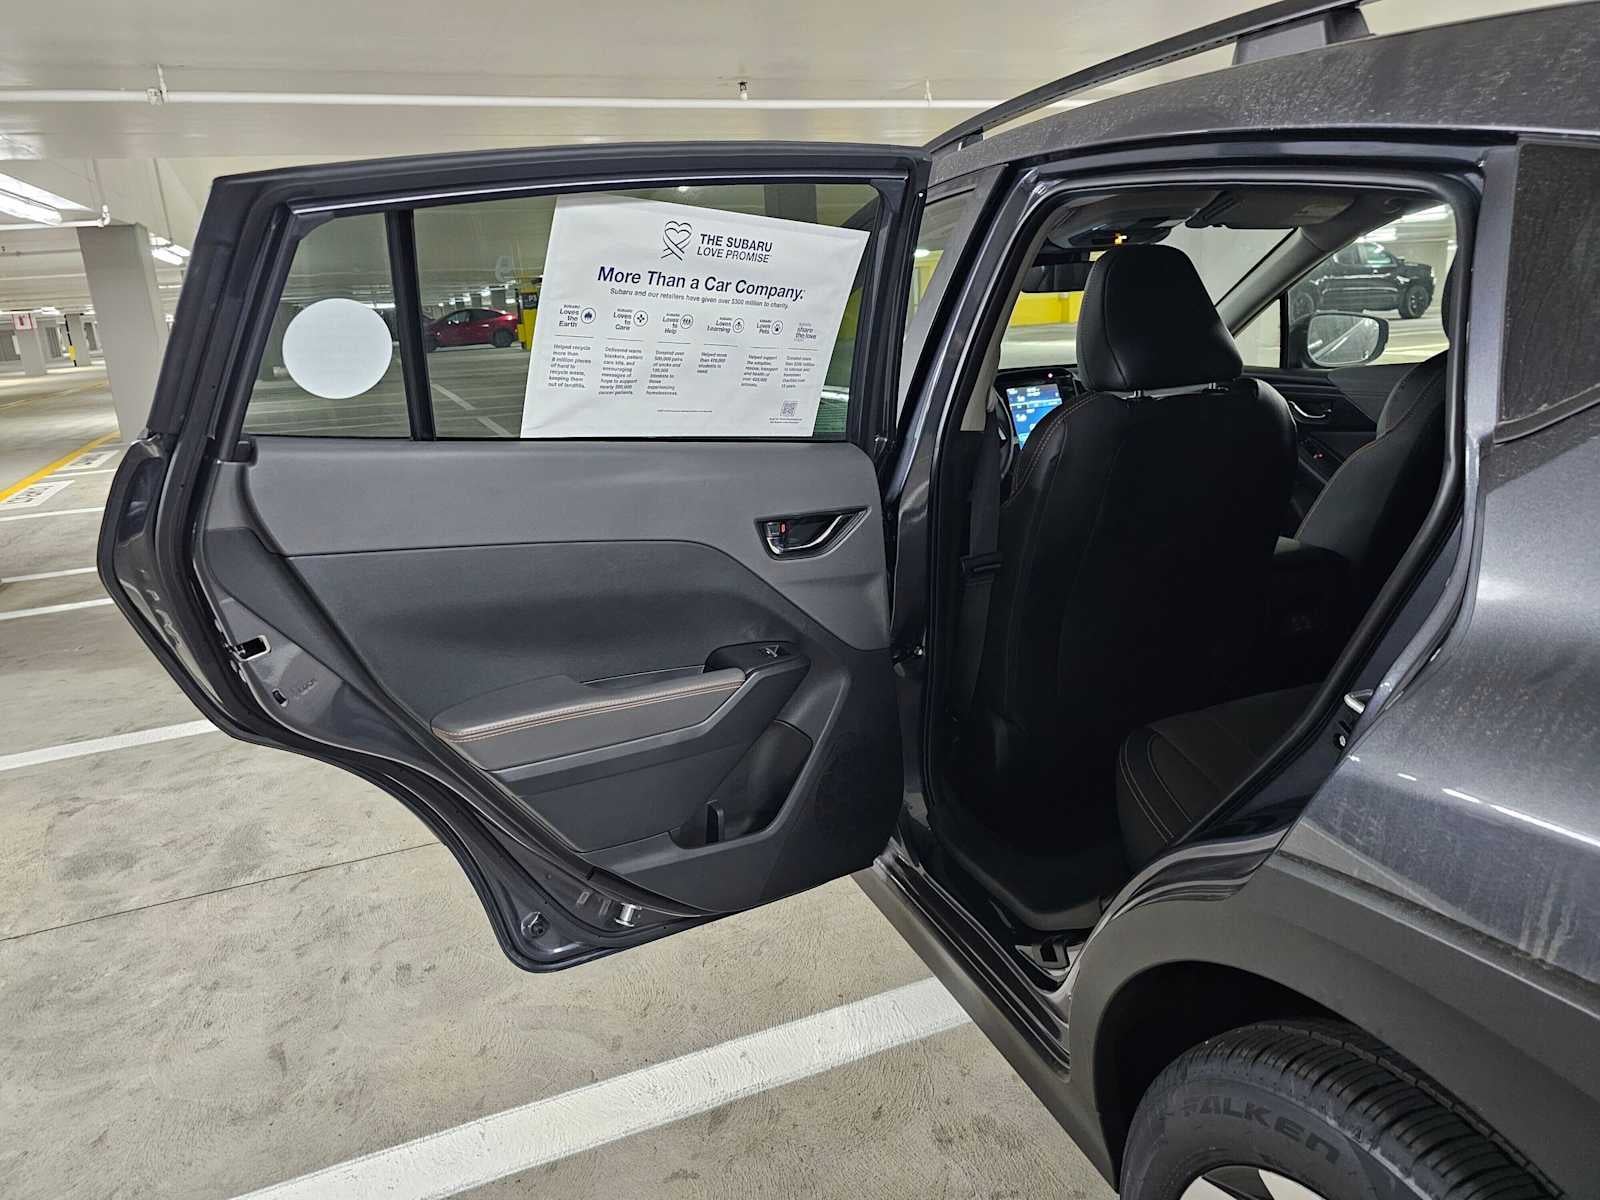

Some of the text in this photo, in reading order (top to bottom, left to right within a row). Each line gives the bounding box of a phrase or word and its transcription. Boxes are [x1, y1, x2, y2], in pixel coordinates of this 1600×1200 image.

[700, 234, 772, 252] THE SUBARU
[697, 247, 770, 263] LOVE PROMISE
[598, 267, 641, 284] More
[648, 271, 686, 288] Than
[690, 278, 699, 289] a
[705, 277, 731, 292] Car
[660, 292, 684, 300] retailers
[707, 325, 731, 333] Learning
[1181, 1096, 1340, 1164] FALKEN
